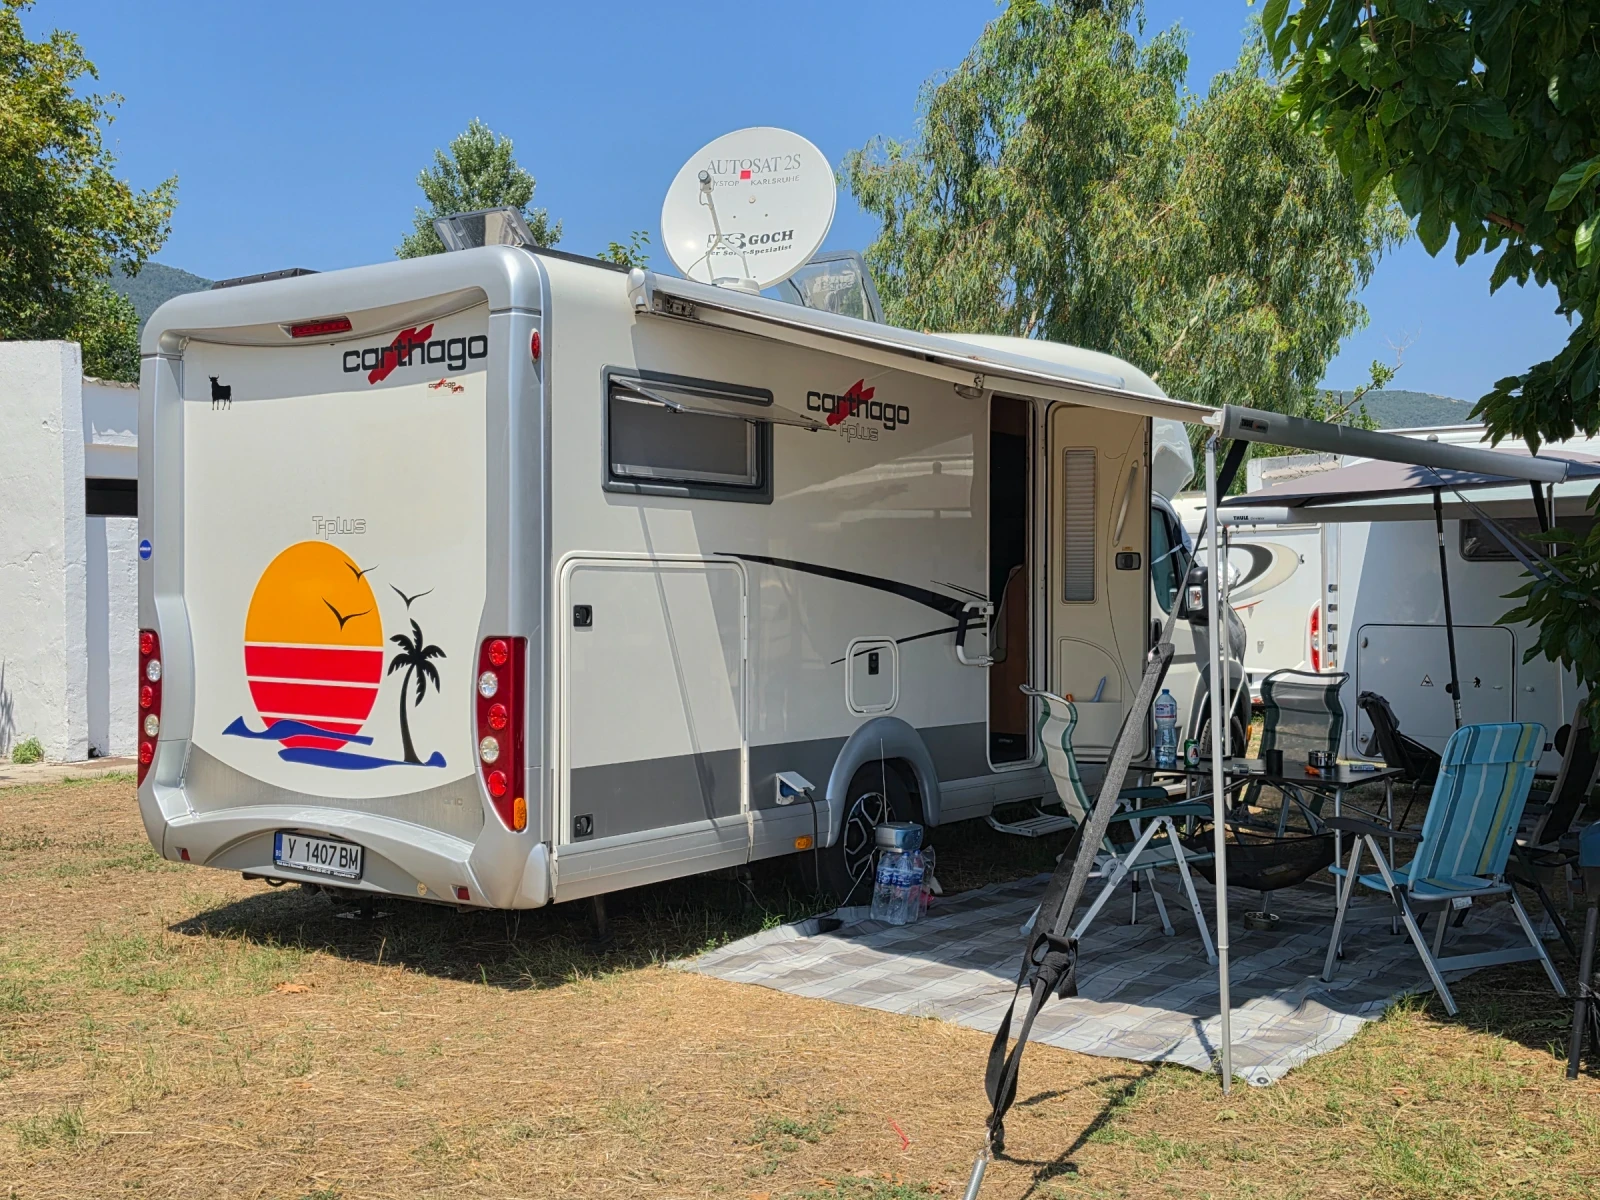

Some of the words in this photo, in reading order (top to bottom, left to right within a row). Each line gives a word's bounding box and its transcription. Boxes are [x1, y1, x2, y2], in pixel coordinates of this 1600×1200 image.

[706, 156, 781, 174] AUTOSAT
[784, 153, 801, 170] 2S
[750, 175, 800, 186] KARLSRUHE
[748, 229, 794, 246] GOCH
[343, 334, 489, 373] carthago
[806, 390, 910, 431] carthago
[839, 419, 879, 443] T-plus
[312, 515, 367, 540] T-plus
[305, 841, 337, 866] 1407
[339, 846, 359, 870] BM
